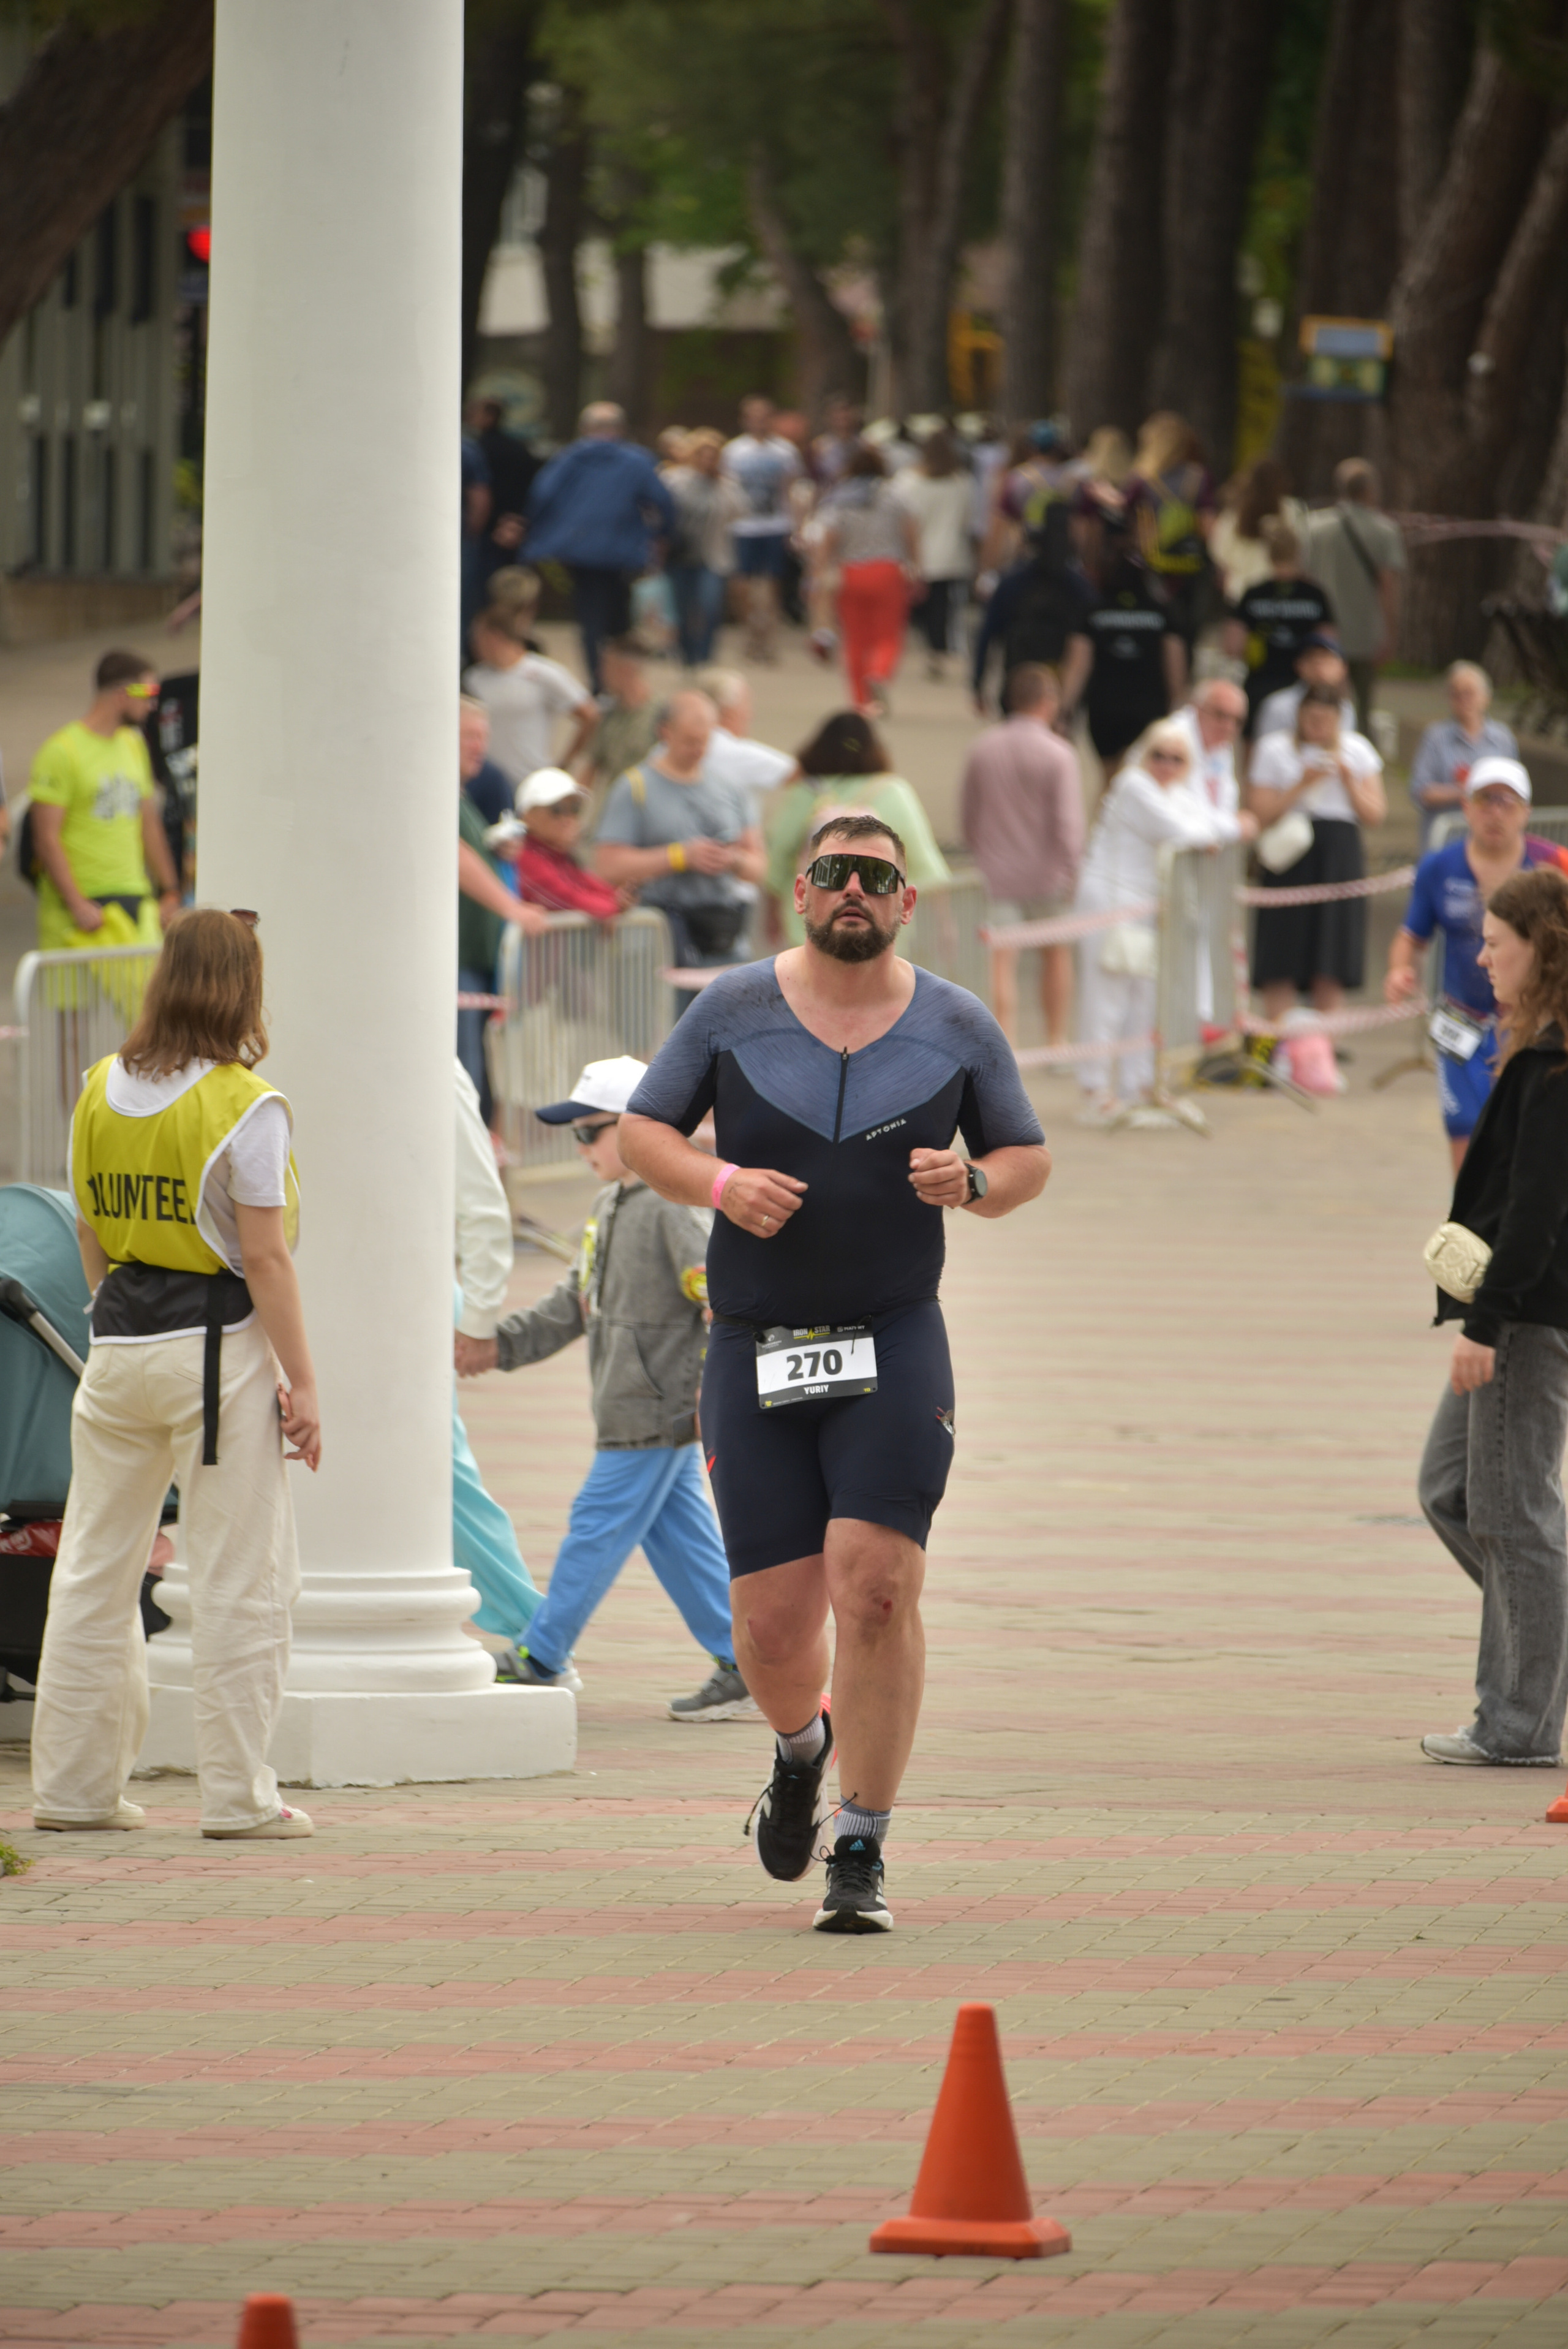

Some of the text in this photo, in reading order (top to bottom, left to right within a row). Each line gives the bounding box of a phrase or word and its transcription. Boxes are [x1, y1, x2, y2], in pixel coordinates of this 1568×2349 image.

[865, 1118, 907, 1141] APTONIA
[793, 1328, 808, 1337] IRON
[786, 1349, 843, 1382] 270
[804, 1385, 829, 1394] YURIY
